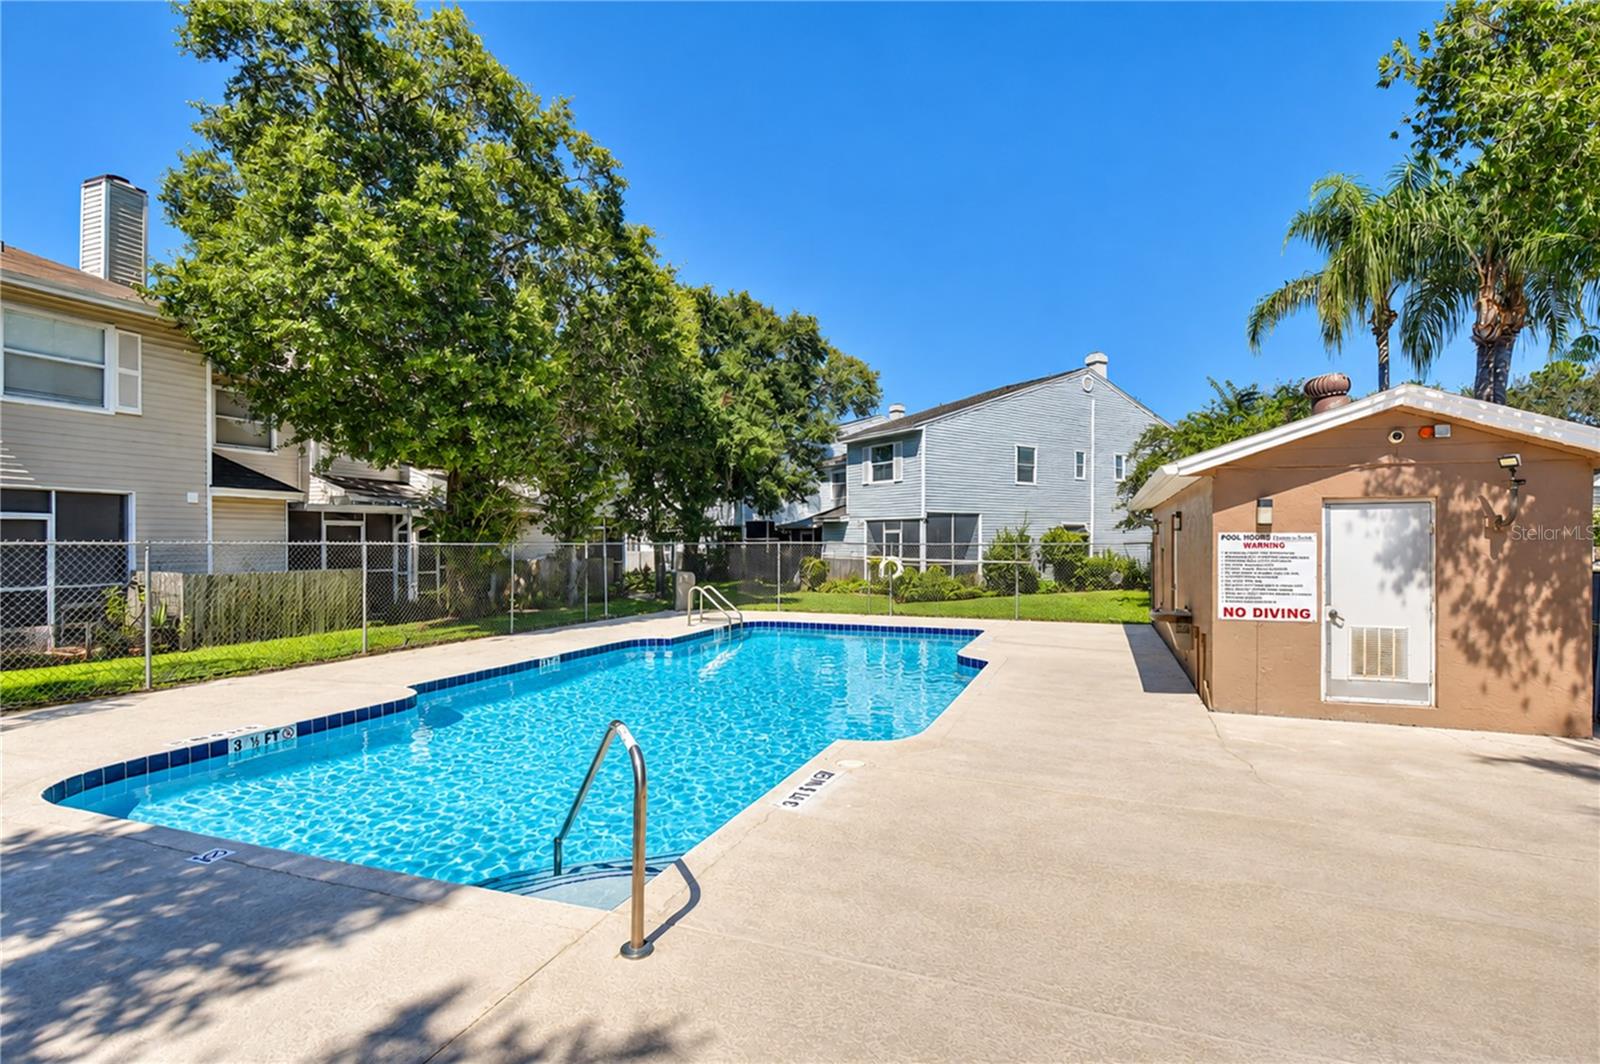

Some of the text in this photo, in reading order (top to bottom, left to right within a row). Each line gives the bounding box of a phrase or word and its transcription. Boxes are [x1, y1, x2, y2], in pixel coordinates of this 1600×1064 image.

[1223, 606, 1311, 619] NO DIVING
[233, 739, 242, 752] 3
[264, 730, 280, 745] FT
